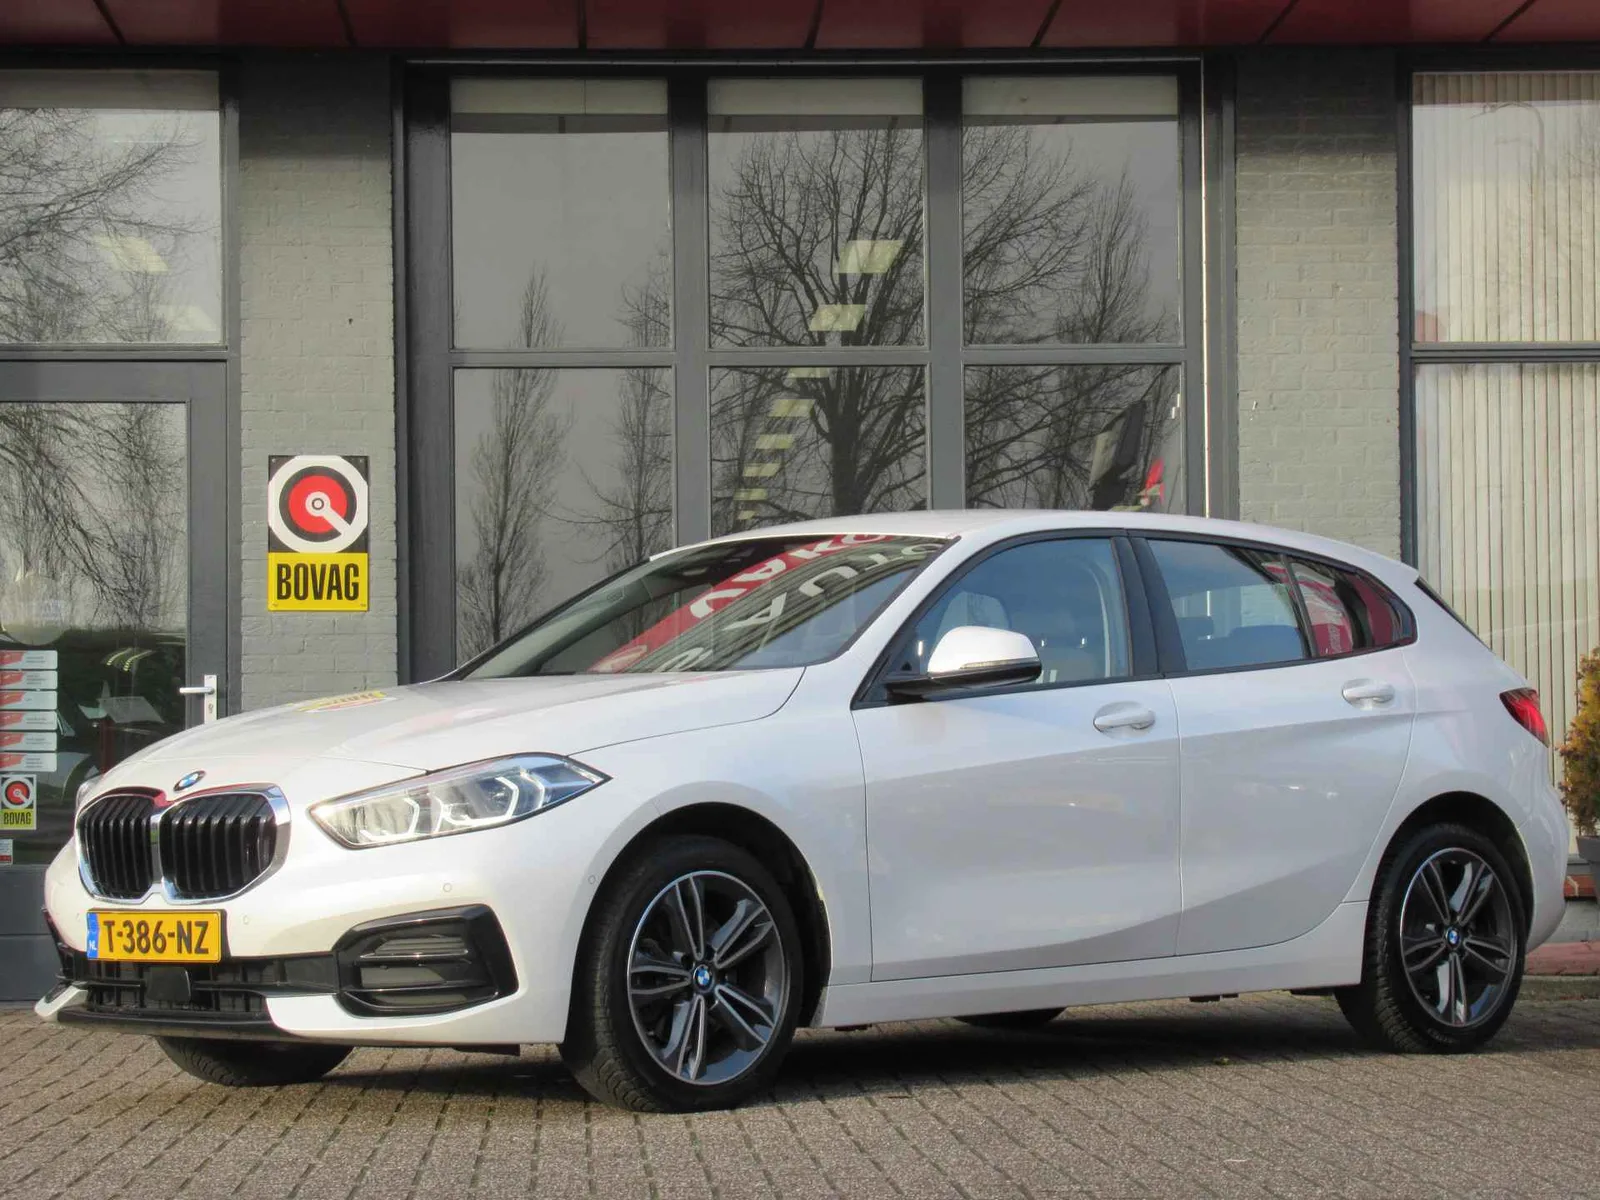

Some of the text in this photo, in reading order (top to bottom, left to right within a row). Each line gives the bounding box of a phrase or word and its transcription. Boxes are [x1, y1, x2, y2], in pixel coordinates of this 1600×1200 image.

[276, 562, 360, 601] BOVAG
[3, 811, 32, 826] BOVAG
[88, 939, 98, 951] NL
[102, 919, 209, 955] T-386-NZ
